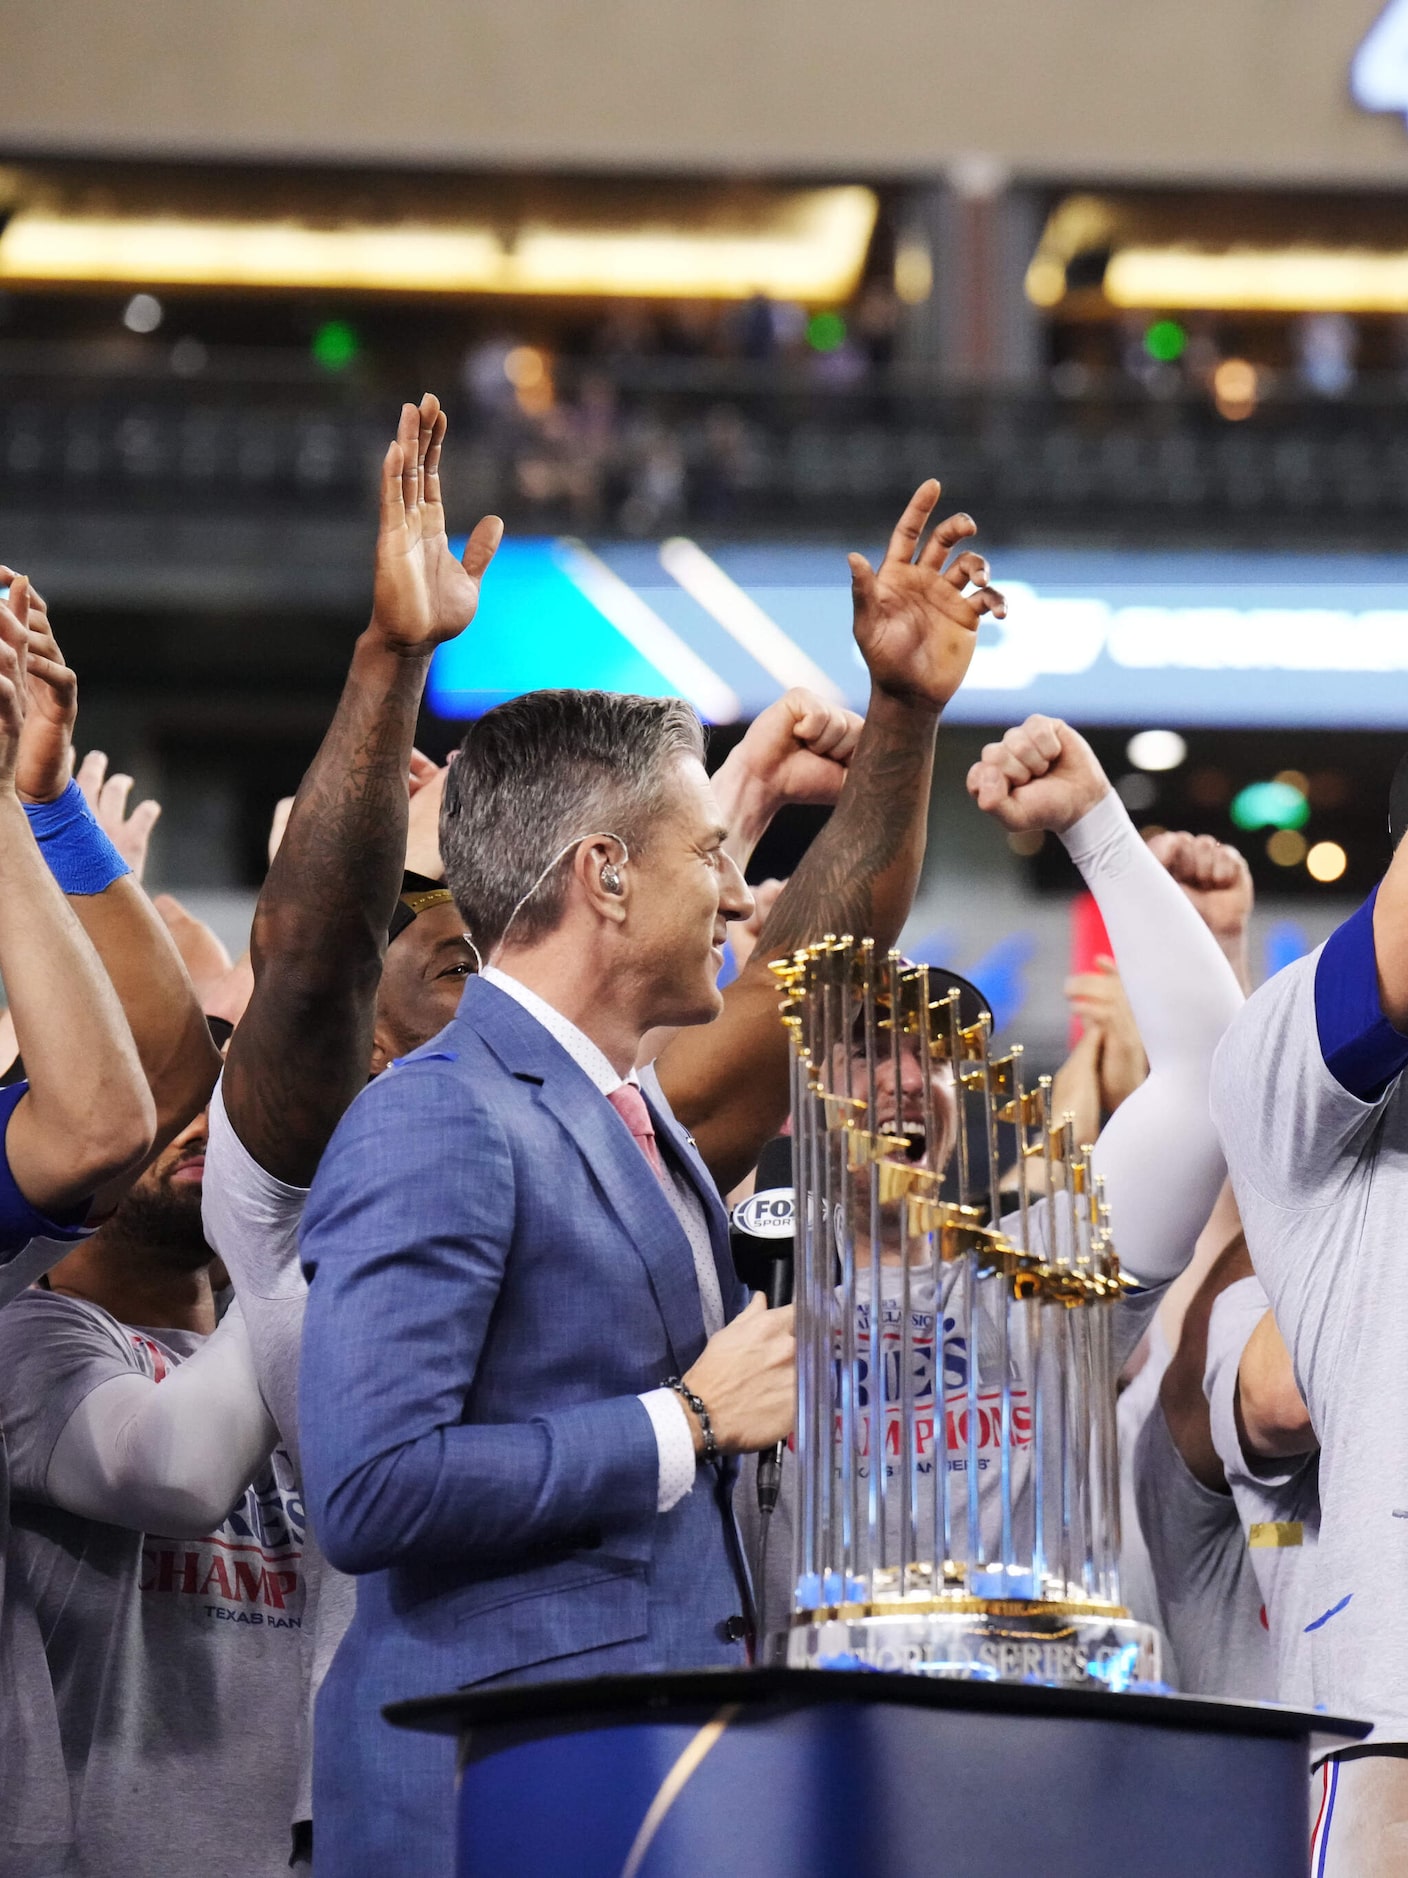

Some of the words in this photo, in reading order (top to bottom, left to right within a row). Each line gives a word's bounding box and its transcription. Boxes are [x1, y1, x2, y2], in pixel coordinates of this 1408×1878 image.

[753, 1218, 796, 1228] SPOR
[204, 1605, 264, 1625] TEXAS
[978, 1642, 1089, 1684] SERIES
